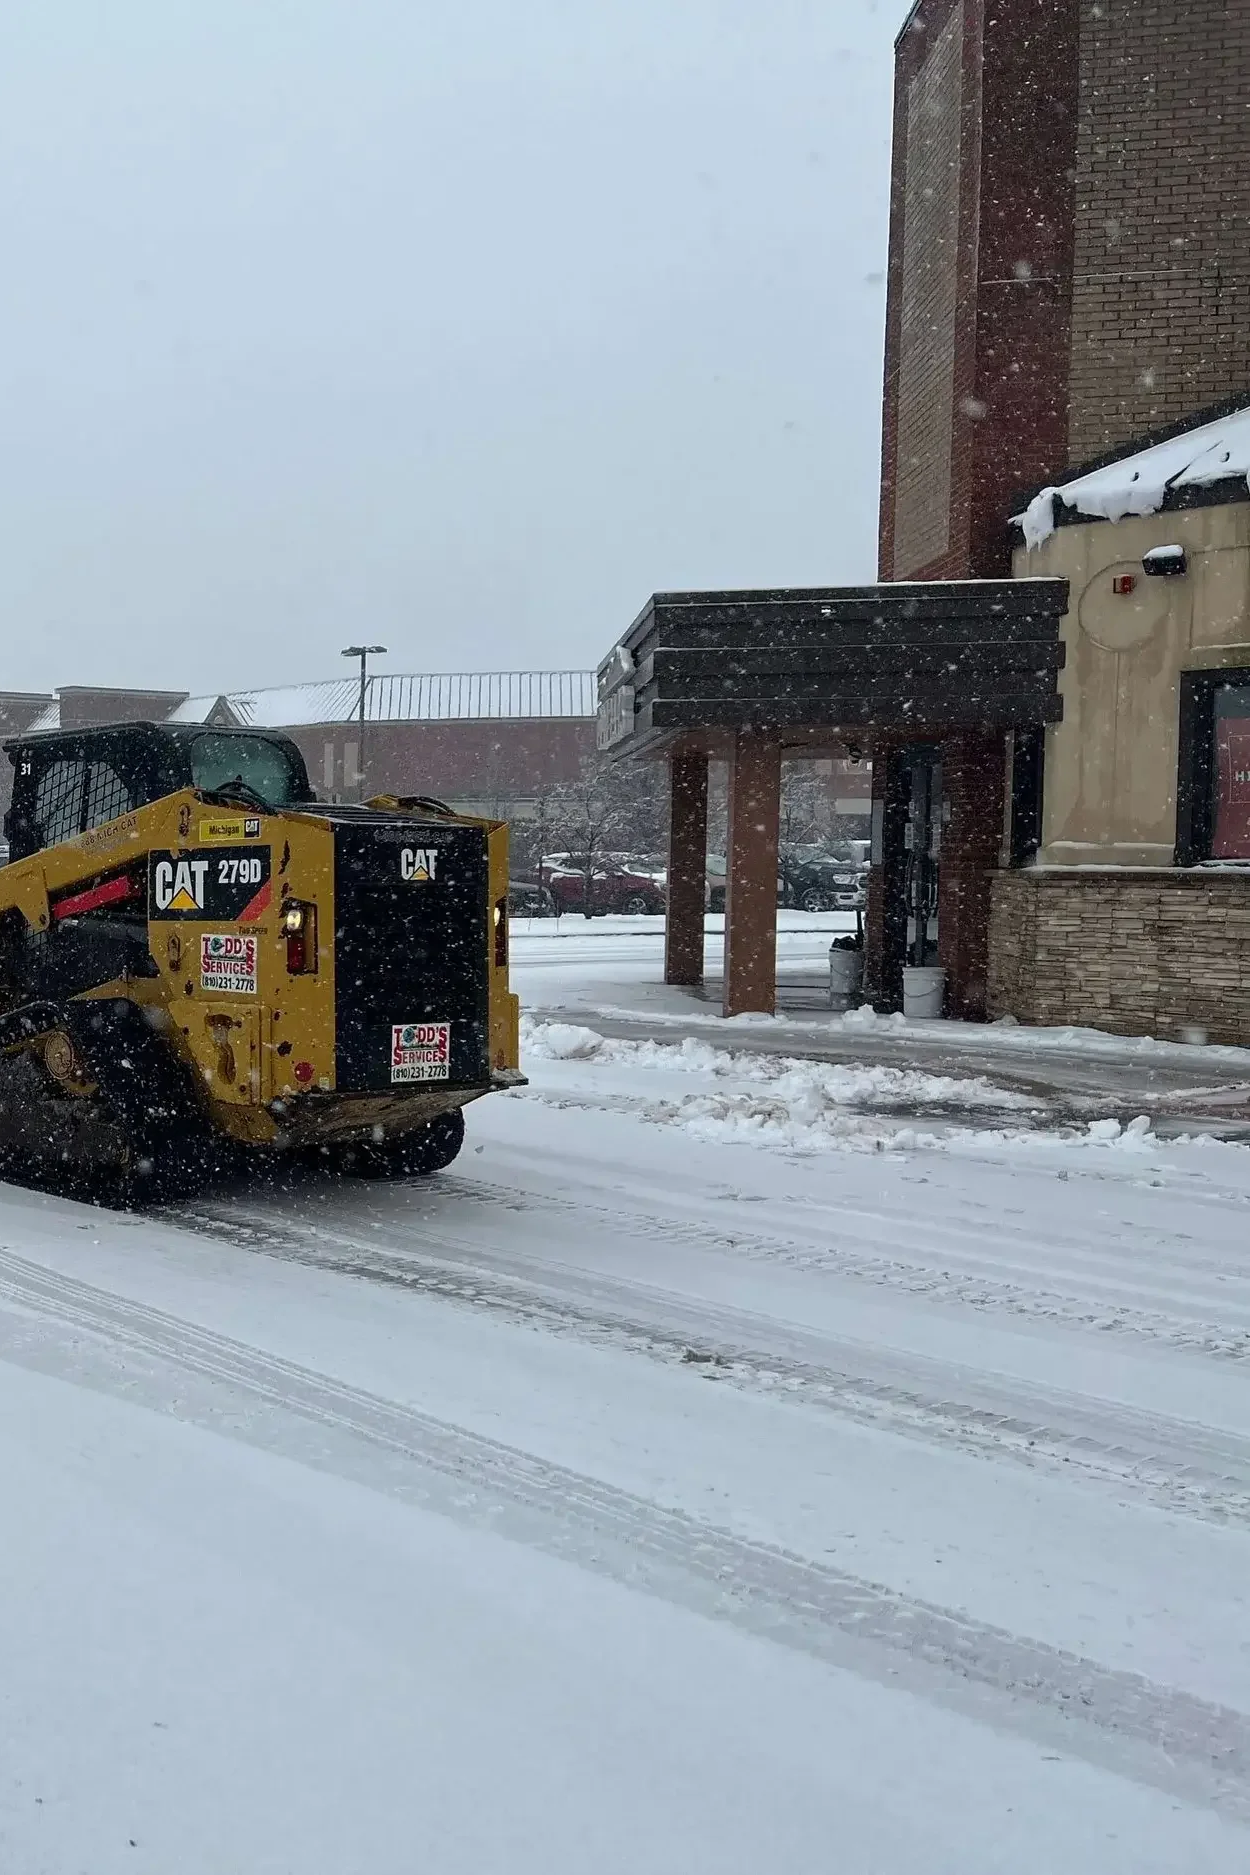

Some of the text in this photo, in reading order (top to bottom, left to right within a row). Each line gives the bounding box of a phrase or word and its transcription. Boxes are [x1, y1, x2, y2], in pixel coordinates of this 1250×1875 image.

[20, 763, 31, 775] 31
[120, 815, 138, 830] CAT
[209, 825, 240, 836] Michigan
[245, 820, 259, 833] CAT
[218, 859, 262, 884] 279D
[401, 848, 438, 881] CAT
[155, 861, 209, 911] CAT
[202, 937, 255, 957] TODD'S
[202, 954, 255, 976] SERVICES
[394, 1026, 447, 1048] TODD'S
[393, 1046, 447, 1065] SERVICES
